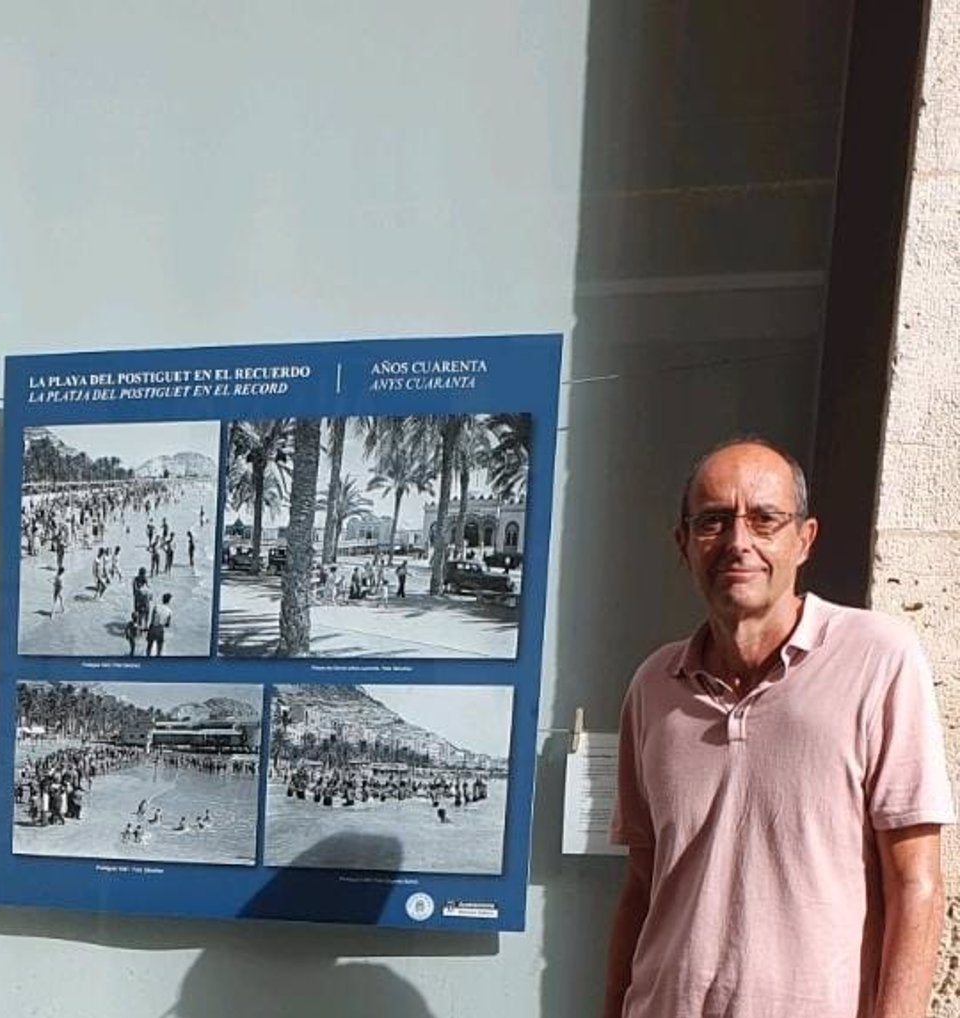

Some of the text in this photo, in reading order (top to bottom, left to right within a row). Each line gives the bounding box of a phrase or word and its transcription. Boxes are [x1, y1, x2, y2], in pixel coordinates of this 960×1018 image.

[371, 359, 488, 375] AÑOS CUARENTA
[29, 365, 310, 388] LA PLAYA DEL POSTIGUET EN EL RECUERDO
[369, 376, 476, 391] ANYS CUARANTA
[28, 382, 288, 403] LA PLATJA DEL POSTIGUET EN EL RECORD
